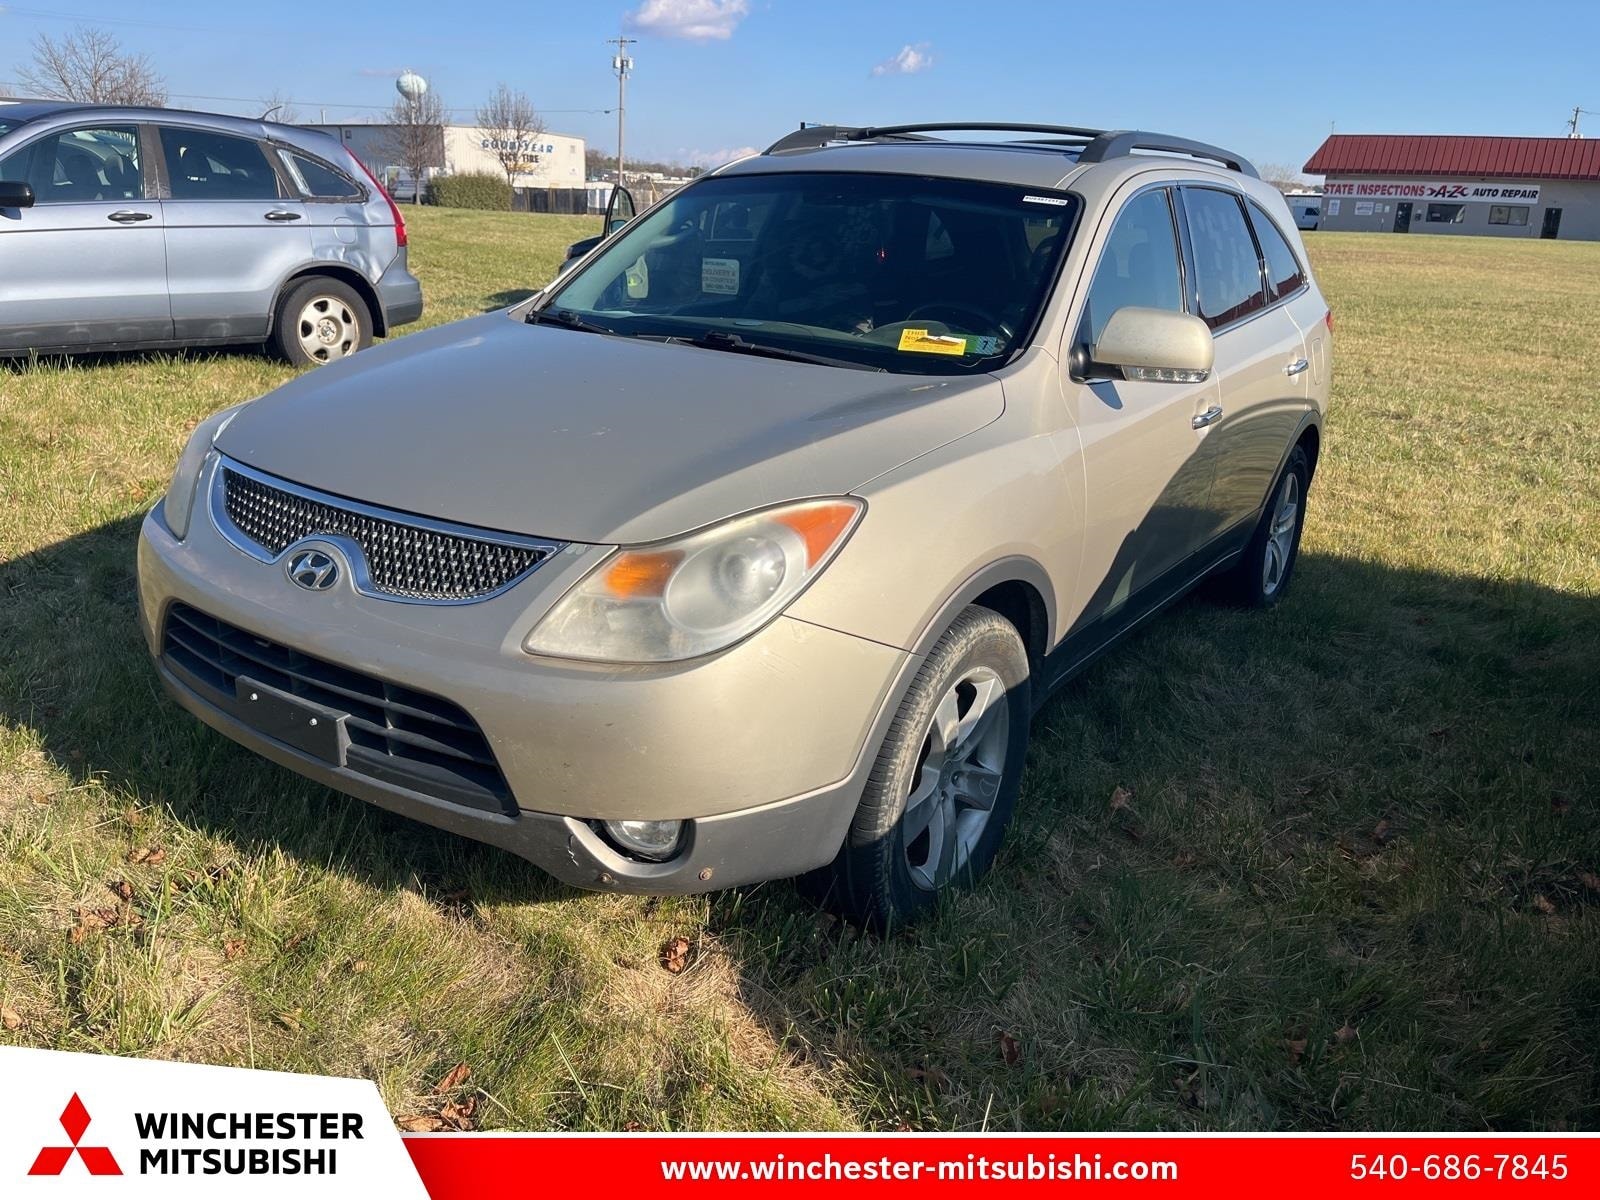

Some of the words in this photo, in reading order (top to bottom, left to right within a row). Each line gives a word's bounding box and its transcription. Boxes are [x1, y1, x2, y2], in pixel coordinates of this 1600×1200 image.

[1323, 183, 1353, 195] STATE
[1356, 184, 1425, 196] INSPECTIONS
[1472, 187, 1499, 198] AUTO
[1500, 188, 1539, 199] REPAIR
[982, 340, 989, 350] 7
